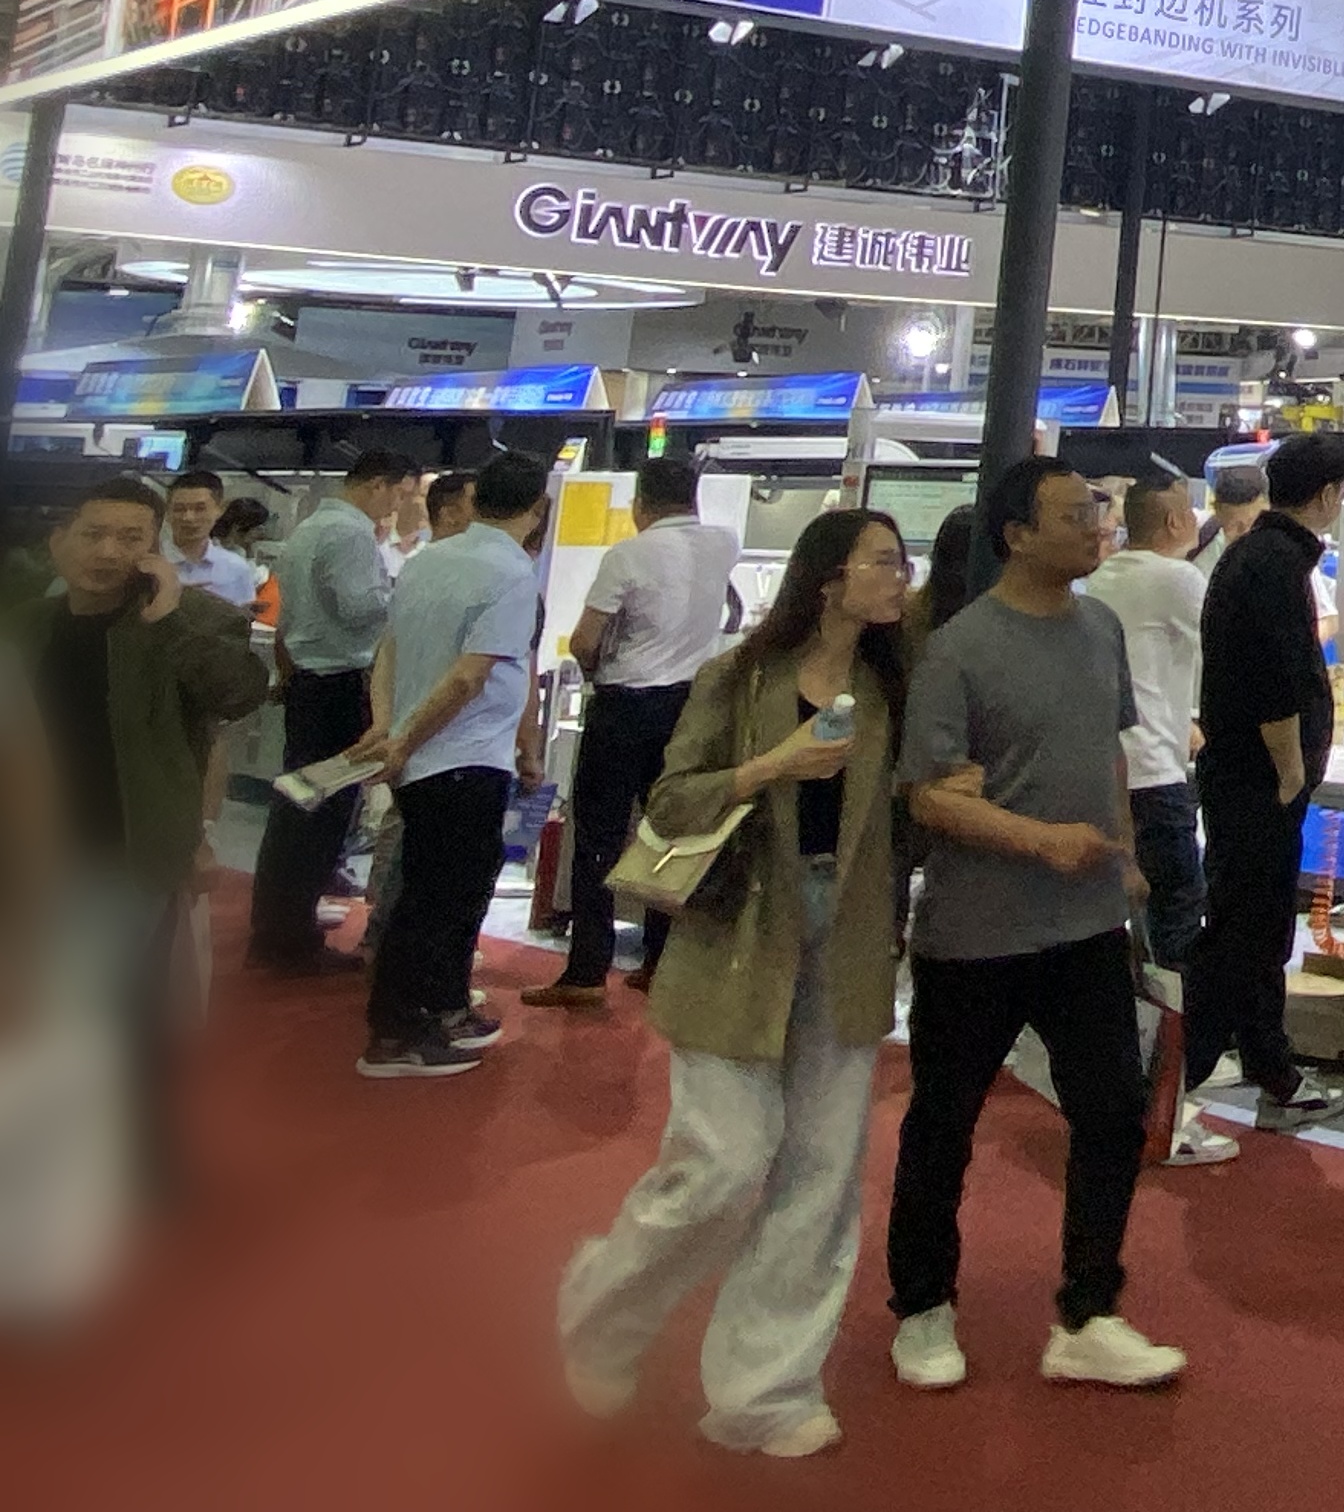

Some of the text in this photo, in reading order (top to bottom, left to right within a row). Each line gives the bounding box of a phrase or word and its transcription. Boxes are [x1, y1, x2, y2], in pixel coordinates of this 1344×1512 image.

[1076, 16, 1215, 56] EDGEBANDING
[1216, 39, 1267, 65] WITH
[812, 221, 973, 277] 建诚伟业
